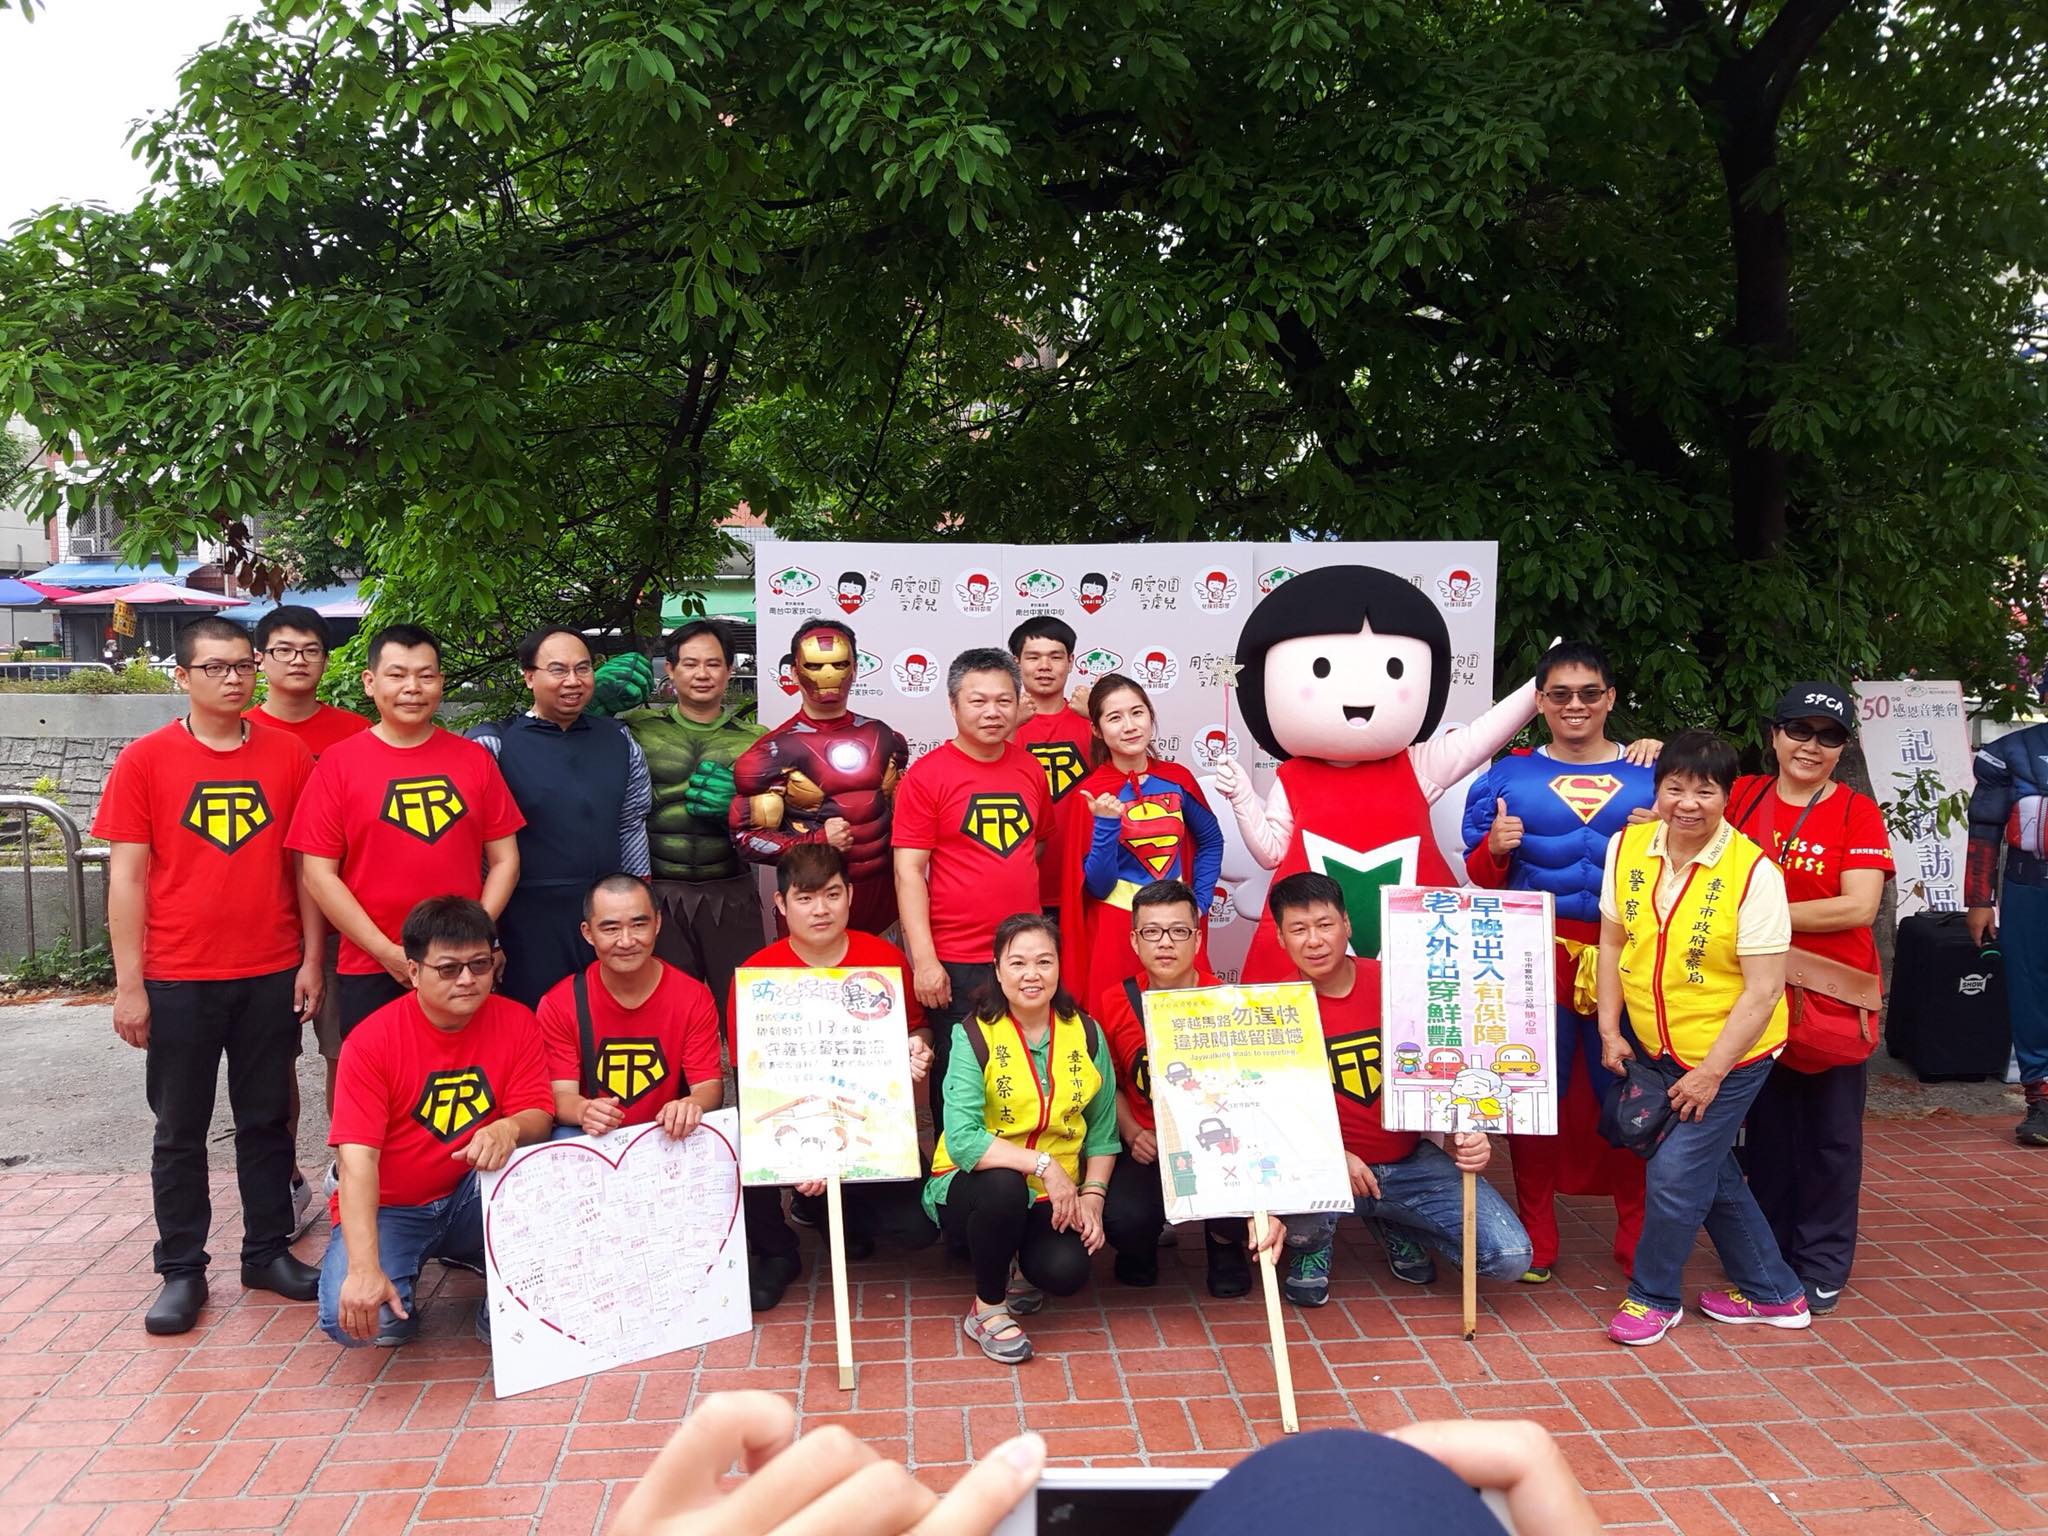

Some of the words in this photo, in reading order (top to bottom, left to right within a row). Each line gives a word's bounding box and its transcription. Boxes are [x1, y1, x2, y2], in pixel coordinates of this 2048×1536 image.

[1804, 693, 1844, 716] SPCA
[1862, 695, 1889, 720] 50
[1686, 878, 1725, 984] 臺中市政府警察局
[1424, 892, 1463, 1047] 老人外出穿鮮豔
[1471, 897, 1508, 1046] 早晚出入有保障
[752, 978, 893, 1011] 防治家庭暴力
[1962, 981, 1985, 989] SHOW
[1172, 1005, 1300, 1031] 穿越馬路勿逞快
[1173, 1028, 1304, 1050] 違規闖越留遺憾
